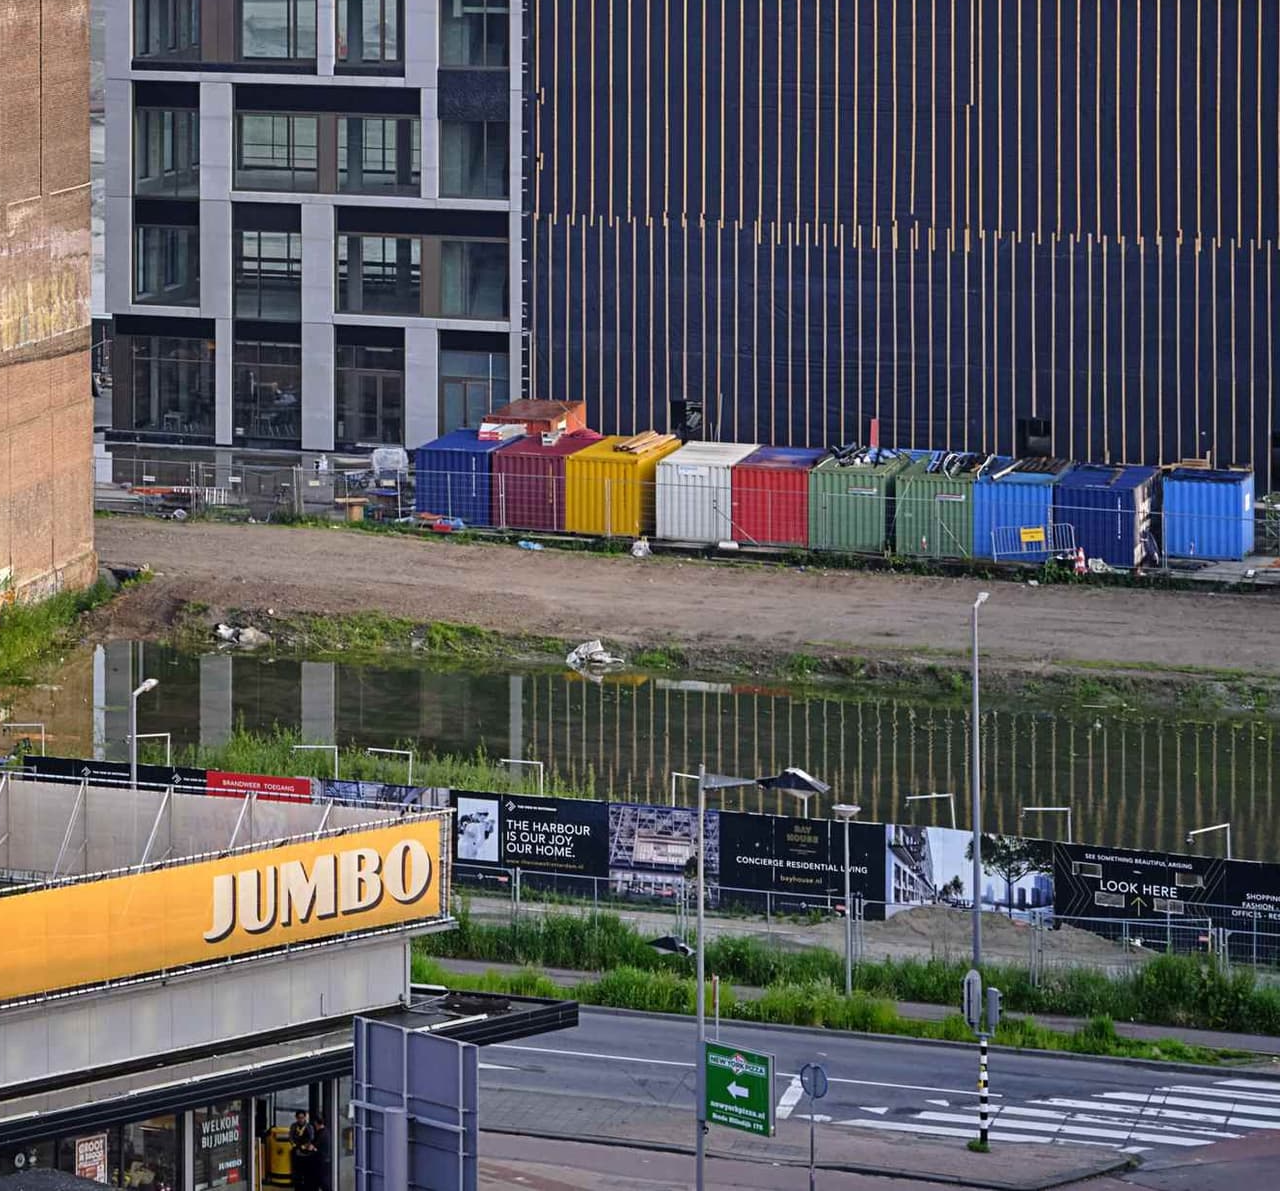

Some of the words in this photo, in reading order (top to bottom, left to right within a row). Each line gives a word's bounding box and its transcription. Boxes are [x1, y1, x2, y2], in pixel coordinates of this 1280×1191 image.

[222, 779, 261, 790] BRANDWEER
[264, 783, 295, 793] TOEGANG
[506, 819, 529, 831] THE
[533, 822, 590, 836] HARBOUR
[506, 831, 517, 841] IS
[520, 832, 546, 844] OUR
[549, 835, 574, 847] JOY,
[506, 842, 532, 855] OUR
[536, 845, 576, 858] HOME.
[736, 856, 783, 868] CONCIERGE
[786, 860, 838, 872] RESIDENTIAL
[840, 863, 868, 874] LVING
[1097, 854, 1133, 864] SOMETHING
[1168, 862, 1193, 870] ARISING
[203, 839, 432, 943] JUMBO
[1100, 879, 1138, 894] LOOK
[1143, 884, 1178, 899] HERE
[1231, 909, 1262, 919] OFFICES
[1242, 901, 1274, 911] FASHION
[201, 1115, 239, 1134] WELKOM
[213, 1130, 239, 1147] JUMBO
